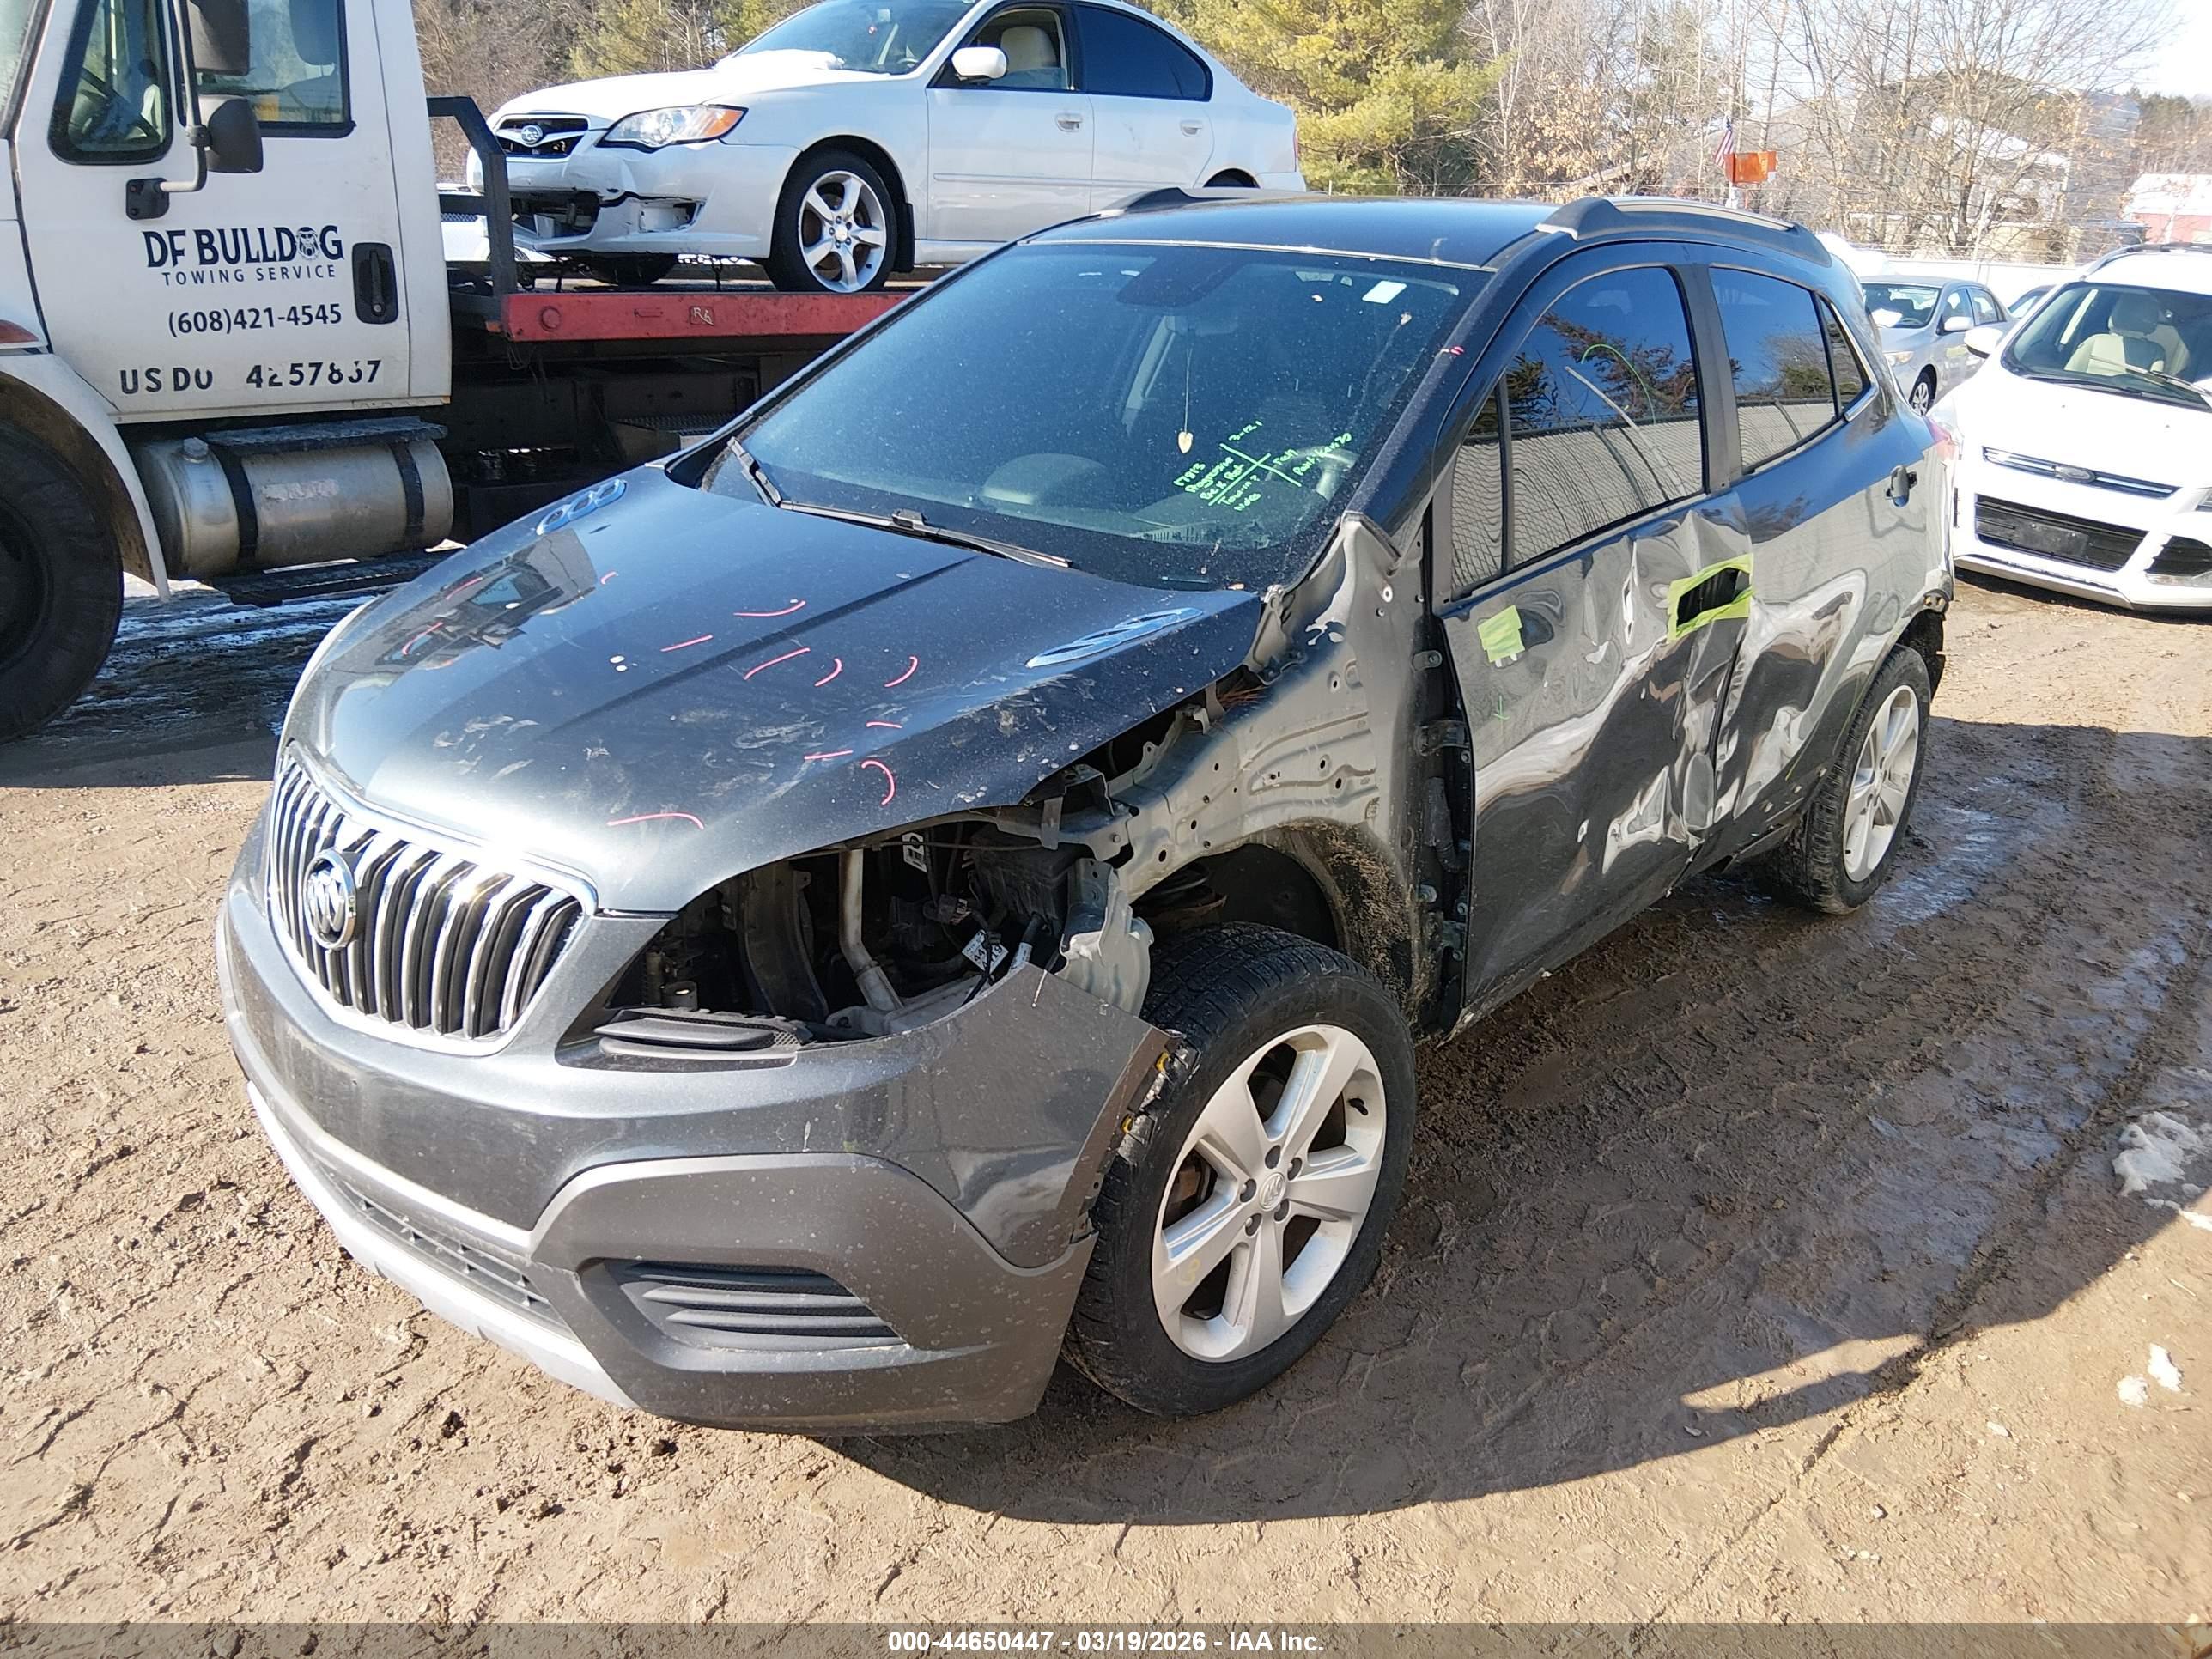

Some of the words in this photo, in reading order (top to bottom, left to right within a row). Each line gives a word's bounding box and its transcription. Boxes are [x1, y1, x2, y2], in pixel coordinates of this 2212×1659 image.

[142, 229, 186, 268] DF
[161, 269, 245, 287] TOWING
[256, 264, 336, 282] SERVICE
[168, 303, 342, 338] (608)421-4545
